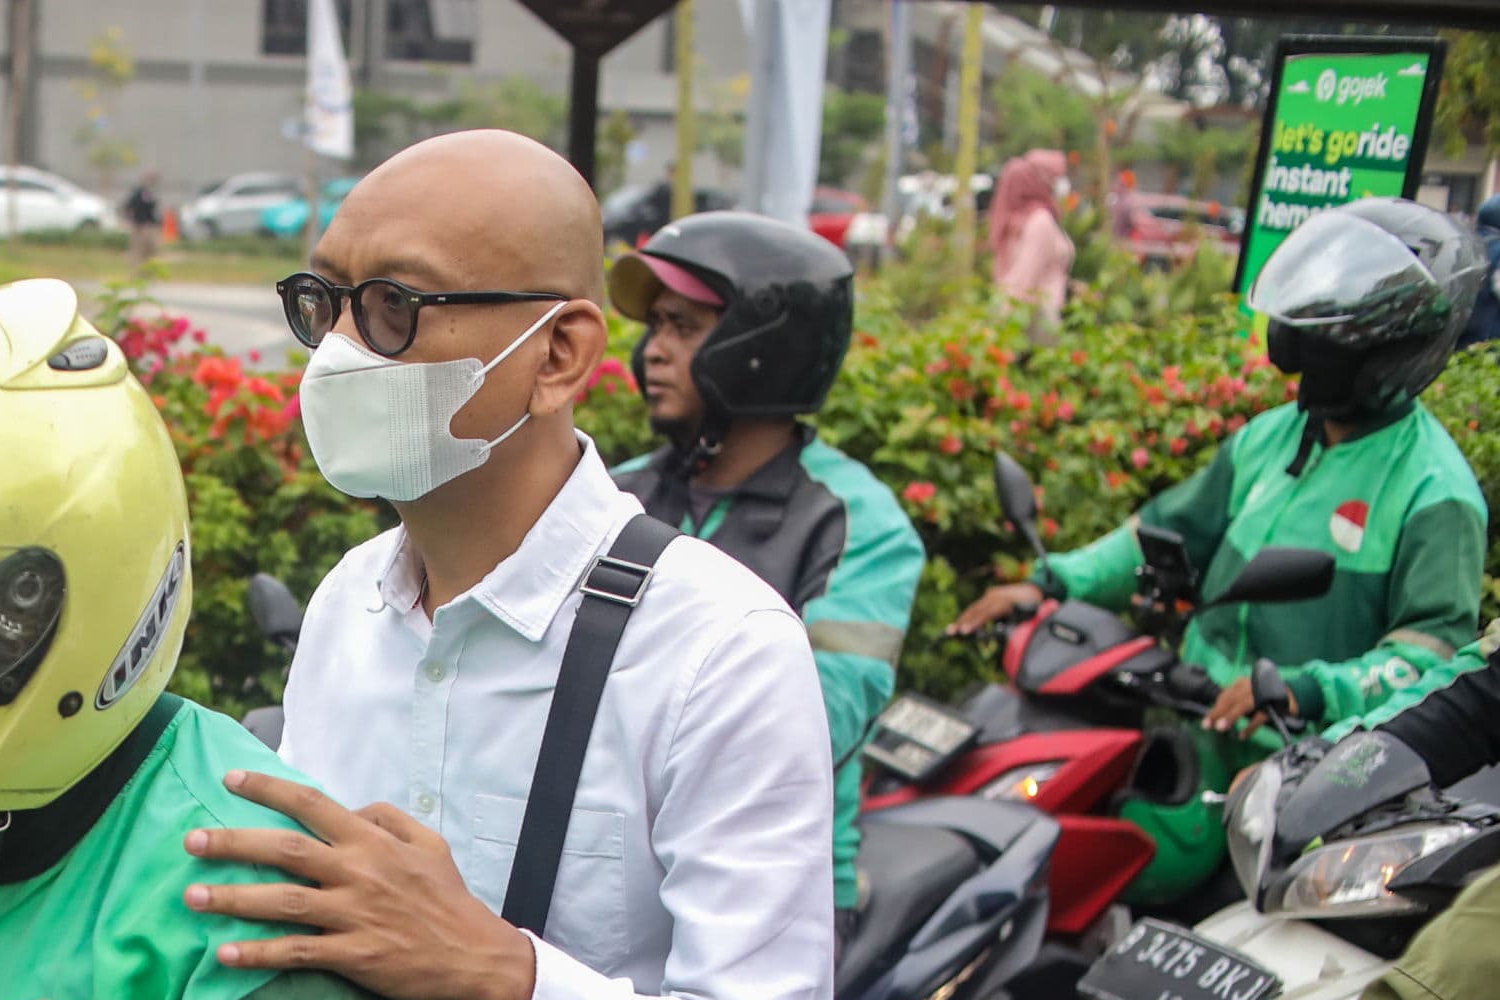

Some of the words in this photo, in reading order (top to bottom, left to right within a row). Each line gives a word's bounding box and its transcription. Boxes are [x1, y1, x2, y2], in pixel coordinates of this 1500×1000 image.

[1337, 73, 1388, 104] gojek
[1275, 119, 1324, 155] let's
[1325, 121, 1409, 165] goride
[1266, 156, 1351, 198] instant
[1260, 194, 1333, 229] hem
[111, 556, 180, 694] INK
